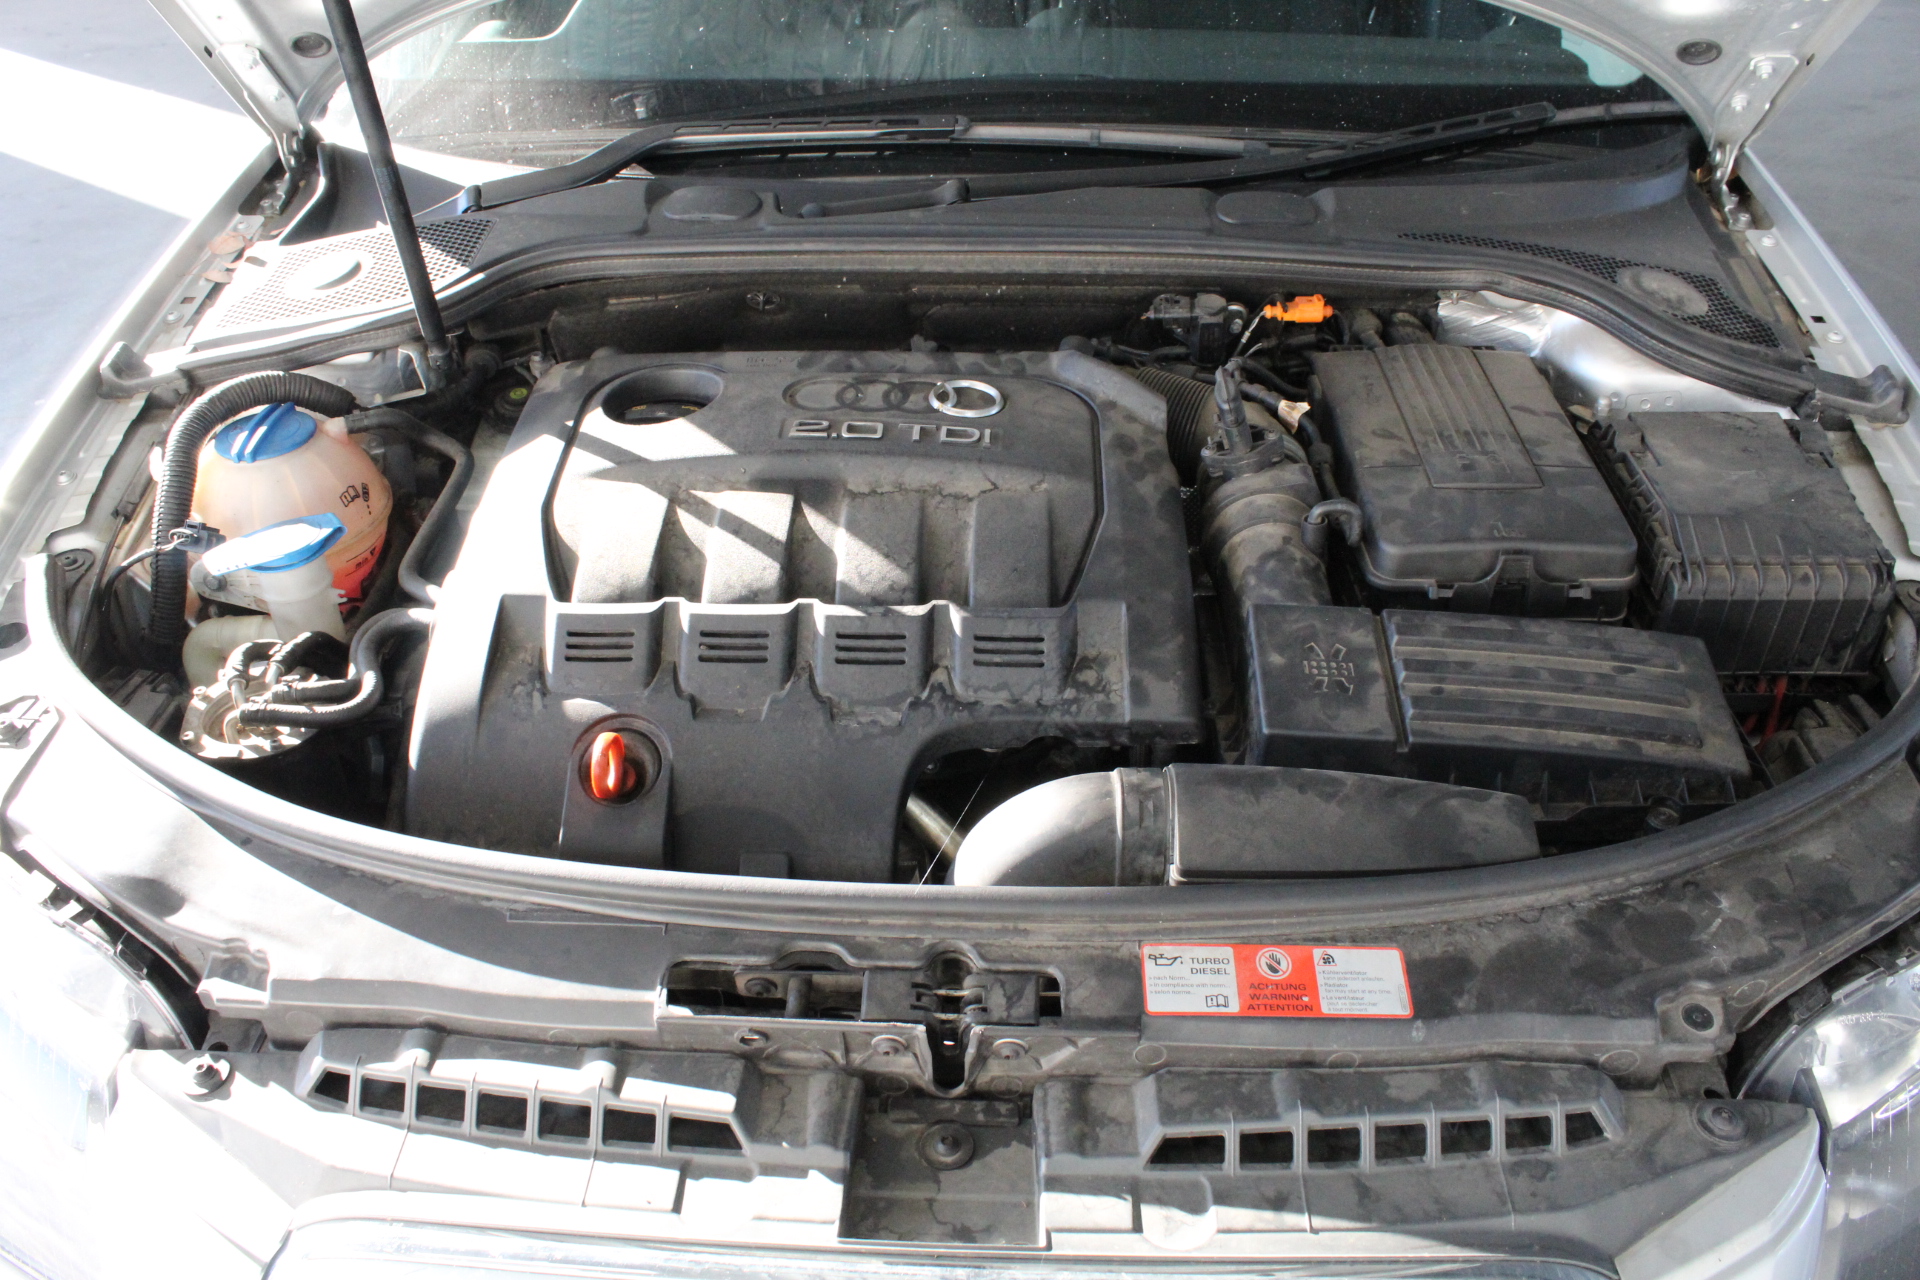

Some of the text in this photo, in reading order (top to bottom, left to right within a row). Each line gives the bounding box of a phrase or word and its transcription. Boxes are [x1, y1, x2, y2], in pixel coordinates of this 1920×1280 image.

[788, 420, 991, 449] 2.0 TDI
[1189, 957, 1230, 965] TURBO
[1190, 967, 1231, 975] DIESEL
[1249, 982, 1307, 991] ACHTUNG
[1247, 1003, 1314, 1012] ATTENTION
